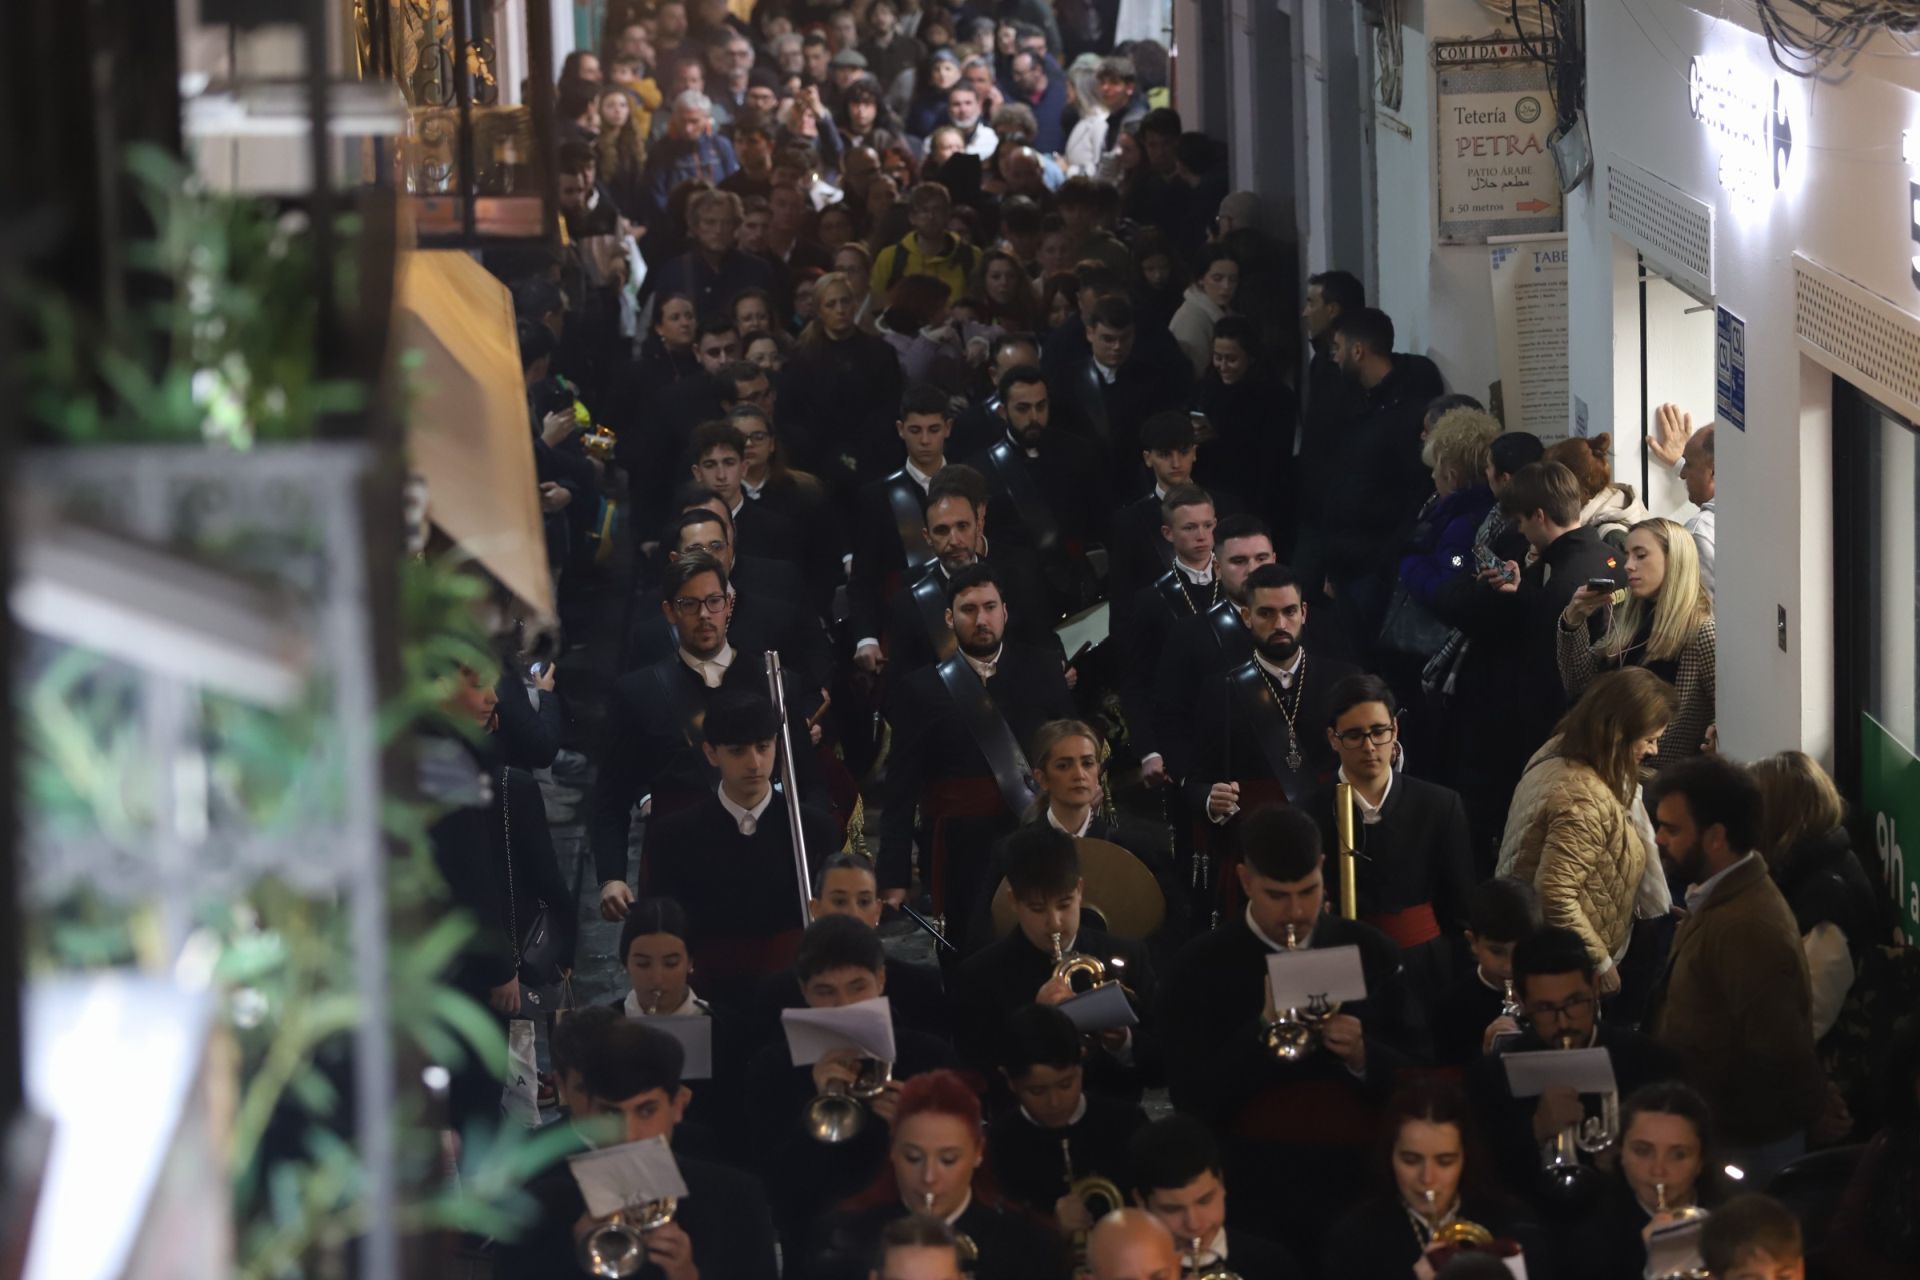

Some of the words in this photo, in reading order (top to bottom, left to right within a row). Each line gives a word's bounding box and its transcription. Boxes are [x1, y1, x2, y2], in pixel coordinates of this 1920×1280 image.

[1438, 45, 1497, 60] COMIDA
[1454, 107, 1506, 124] Tetería
[1455, 132, 1544, 158] PETRA
[1467, 167, 1498, 177] PATIO
[1500, 165, 1533, 176] ÁRABE
[1457, 203, 1469, 214] 50
[1472, 202, 1504, 212] metros
[1876, 811, 1904, 908] 9h
